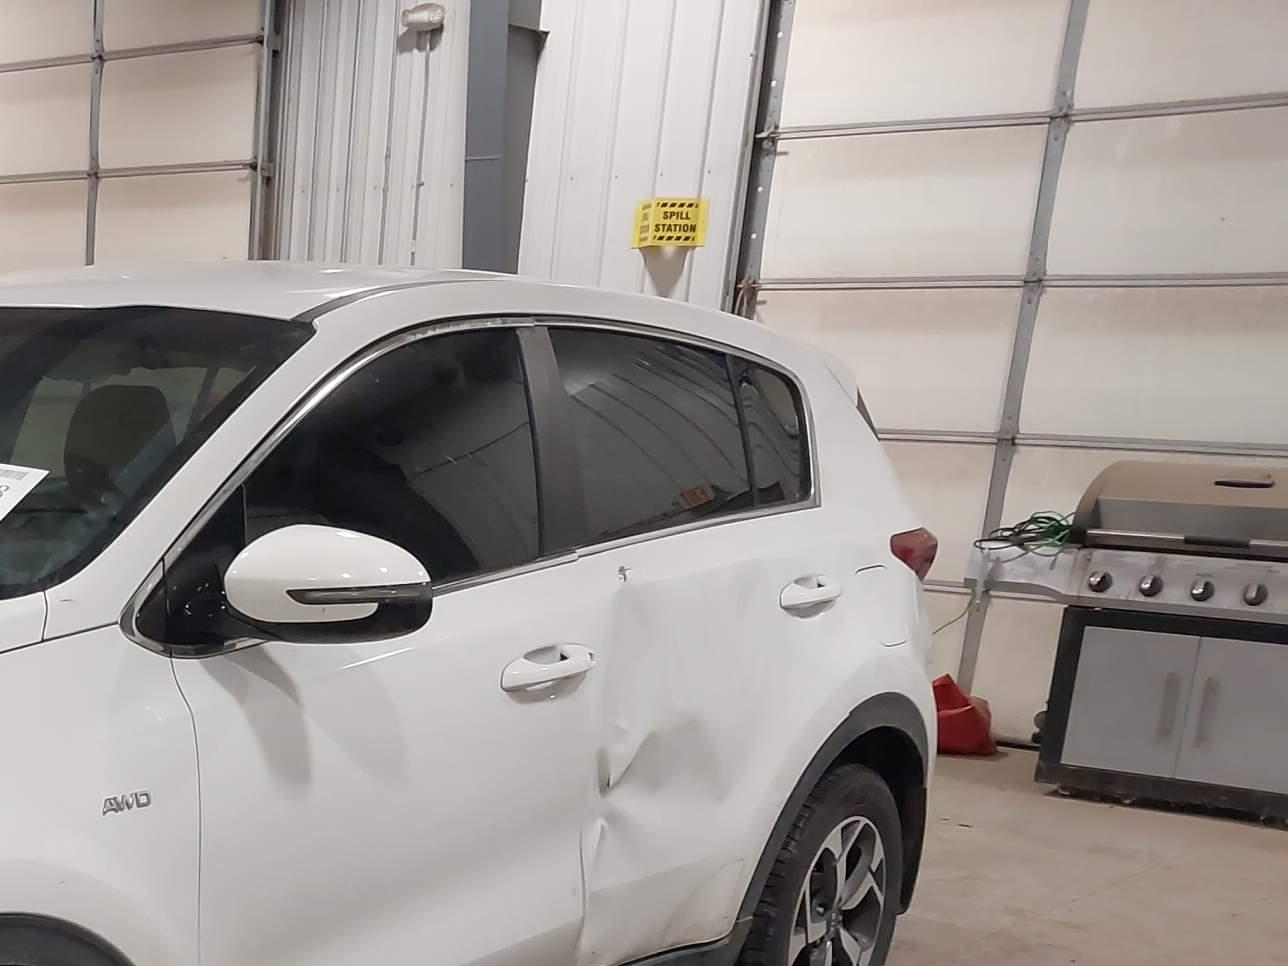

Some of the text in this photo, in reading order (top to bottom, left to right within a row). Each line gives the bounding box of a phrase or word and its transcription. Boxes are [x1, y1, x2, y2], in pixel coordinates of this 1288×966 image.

[662, 211, 691, 220] SPILL
[654, 223, 696, 233] STATION
[102, 790, 151, 816] AWD
